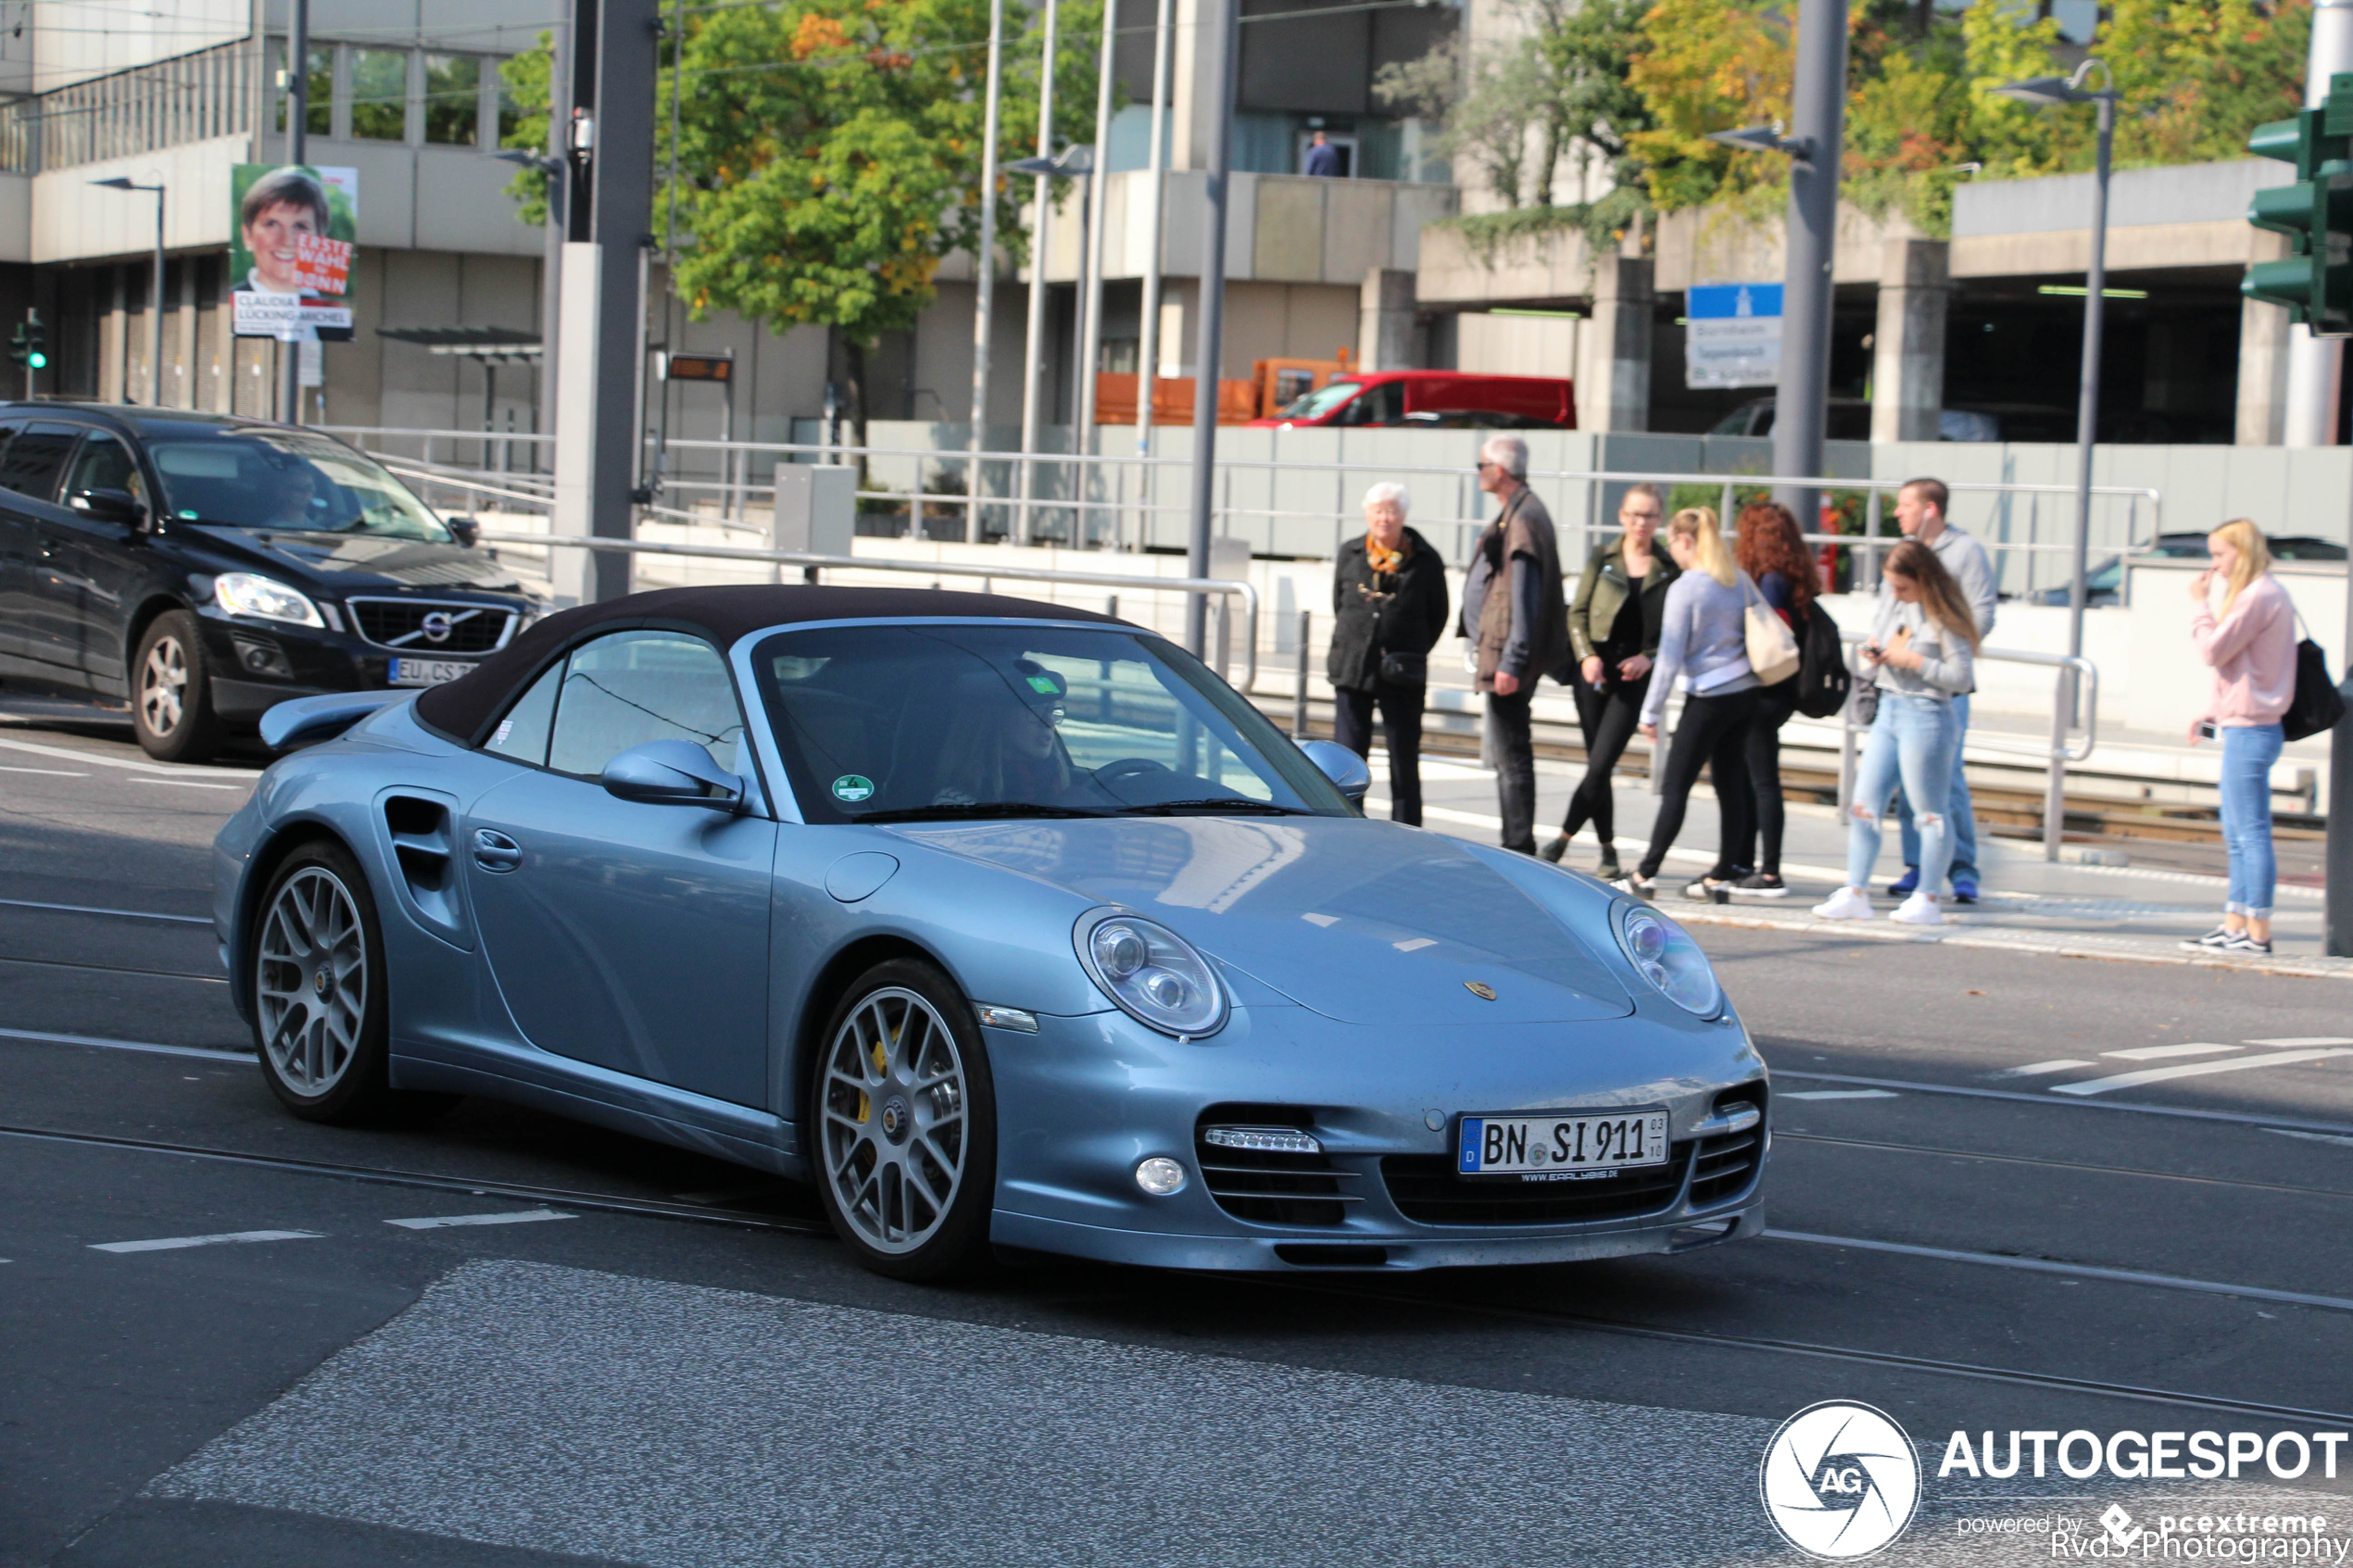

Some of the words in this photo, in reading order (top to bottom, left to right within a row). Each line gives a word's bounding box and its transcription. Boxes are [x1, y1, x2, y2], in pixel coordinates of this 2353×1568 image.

[298, 234, 352, 256] ERSTE
[299, 247, 350, 271] WAHL
[294, 270, 347, 294] BONN
[238, 295, 294, 307] CLAUDIA
[399, 661, 422, 678] EU
[433, 663, 453, 681] CS
[848, 776, 859, 787] 4
[1651, 1118, 1664, 1130] 03
[1484, 1123, 1527, 1164] BN
[1551, 1122, 1586, 1162] SI
[1596, 1119, 1644, 1160] 911
[1466, 1150, 1475, 1162] D
[1651, 1145, 1662, 1158] 10
